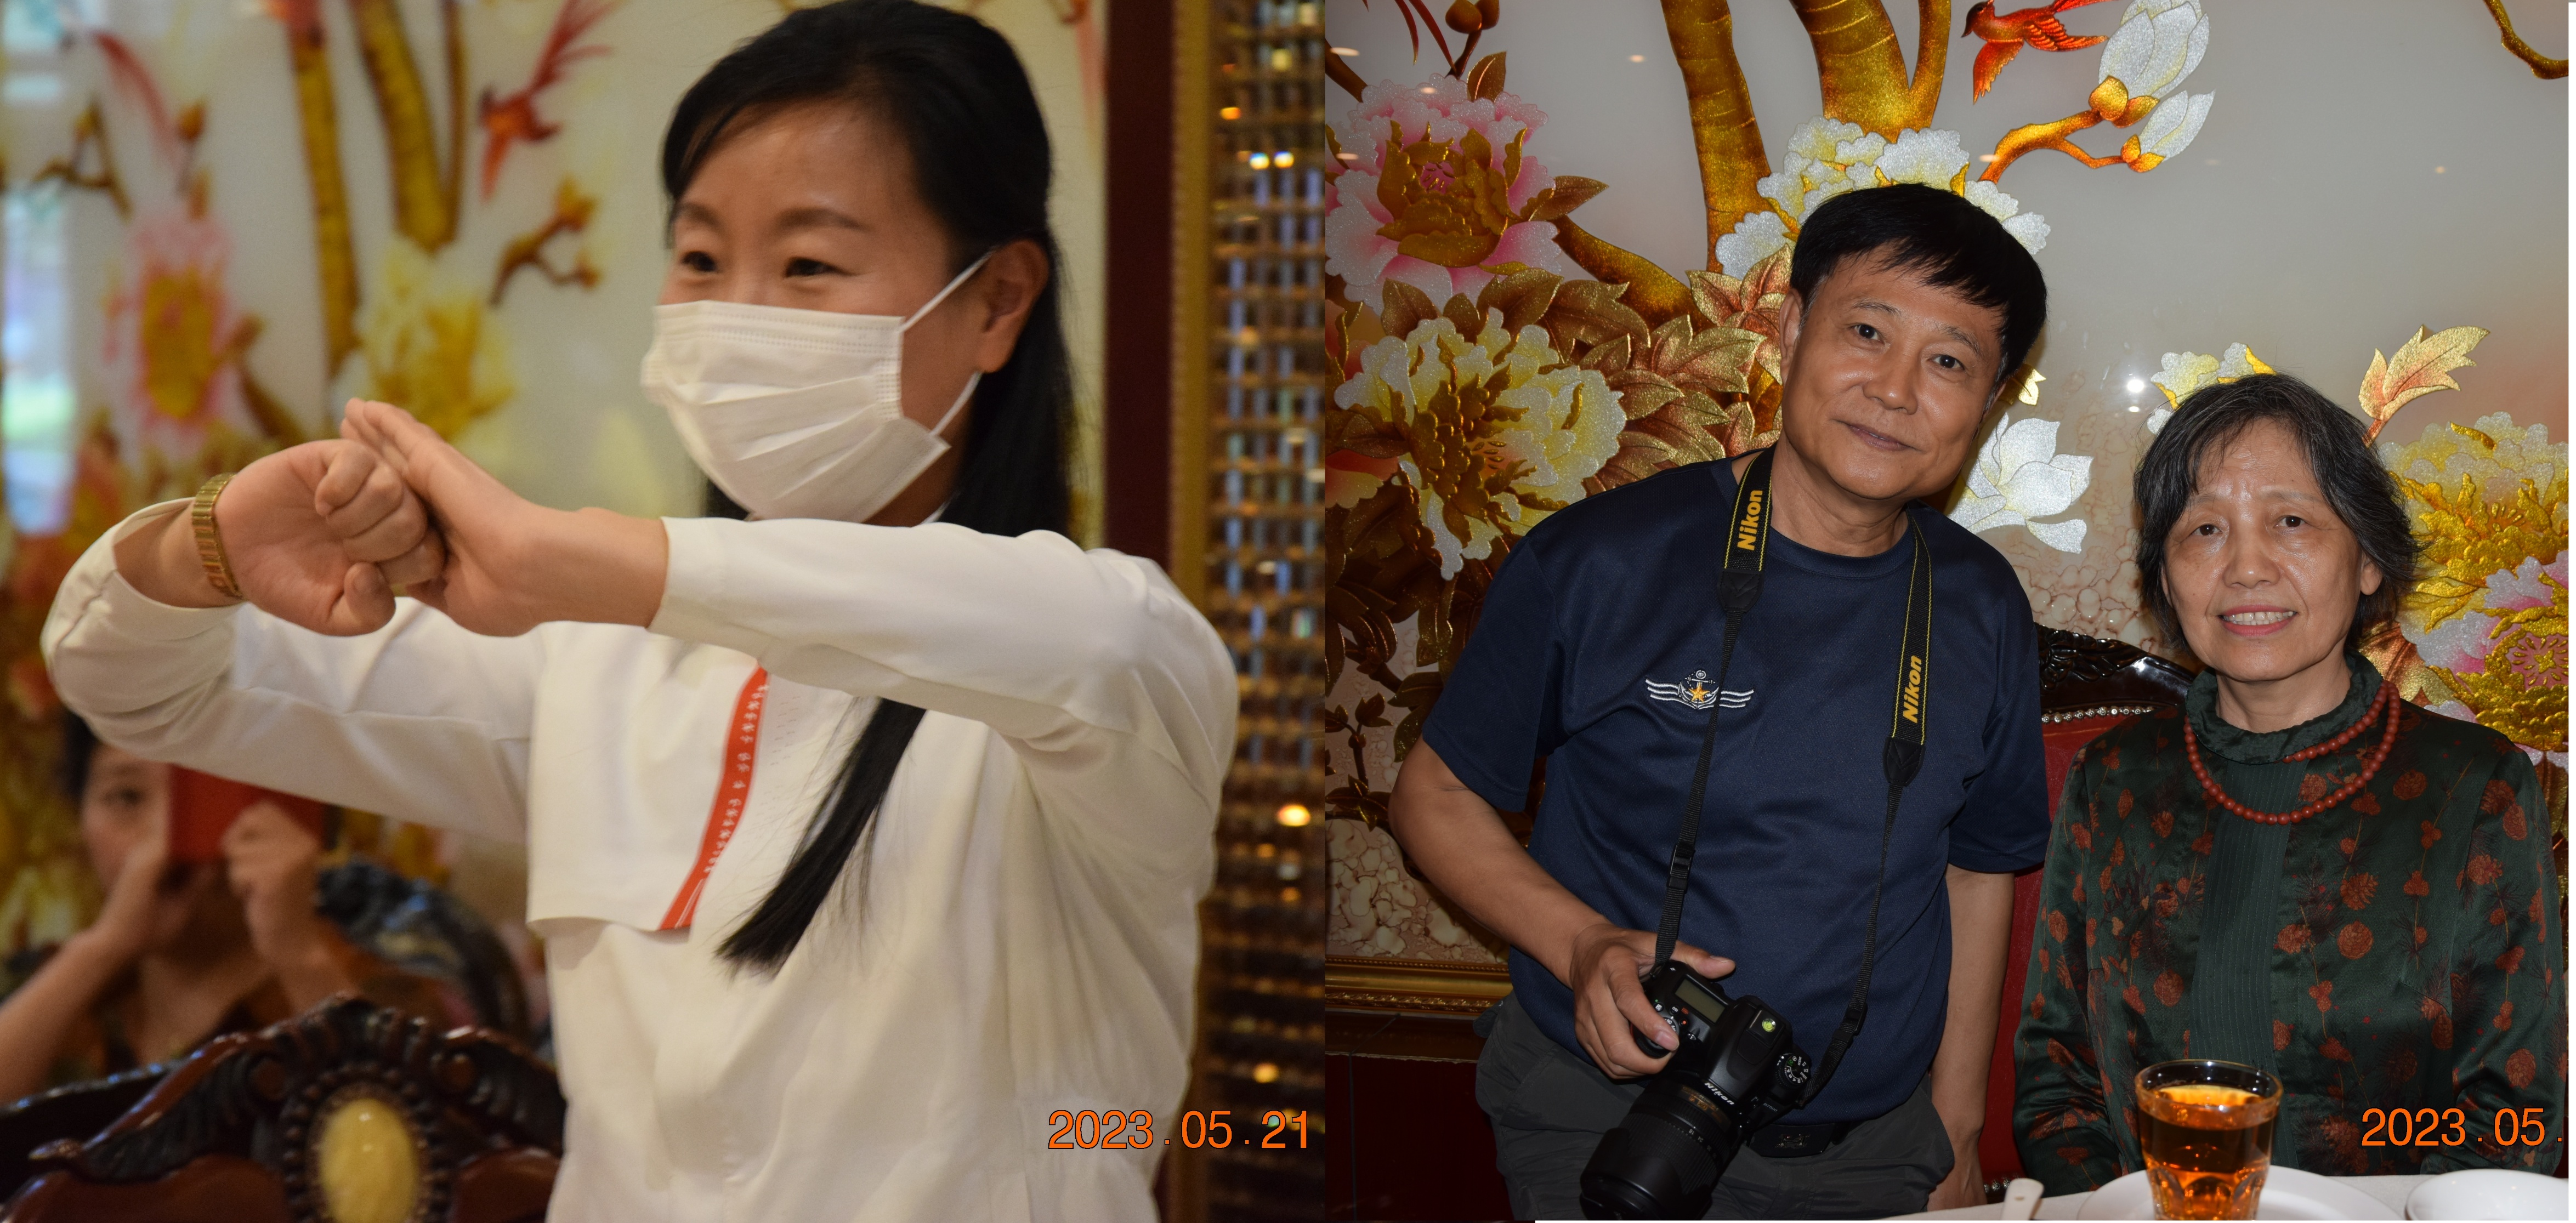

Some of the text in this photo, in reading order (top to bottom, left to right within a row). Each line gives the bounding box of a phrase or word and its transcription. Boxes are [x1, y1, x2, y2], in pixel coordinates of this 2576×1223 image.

[1737, 490, 1763, 551] Nikon
[1903, 655, 1922, 724] Nikon
[1704, 1083, 1734, 1105] Nikon
